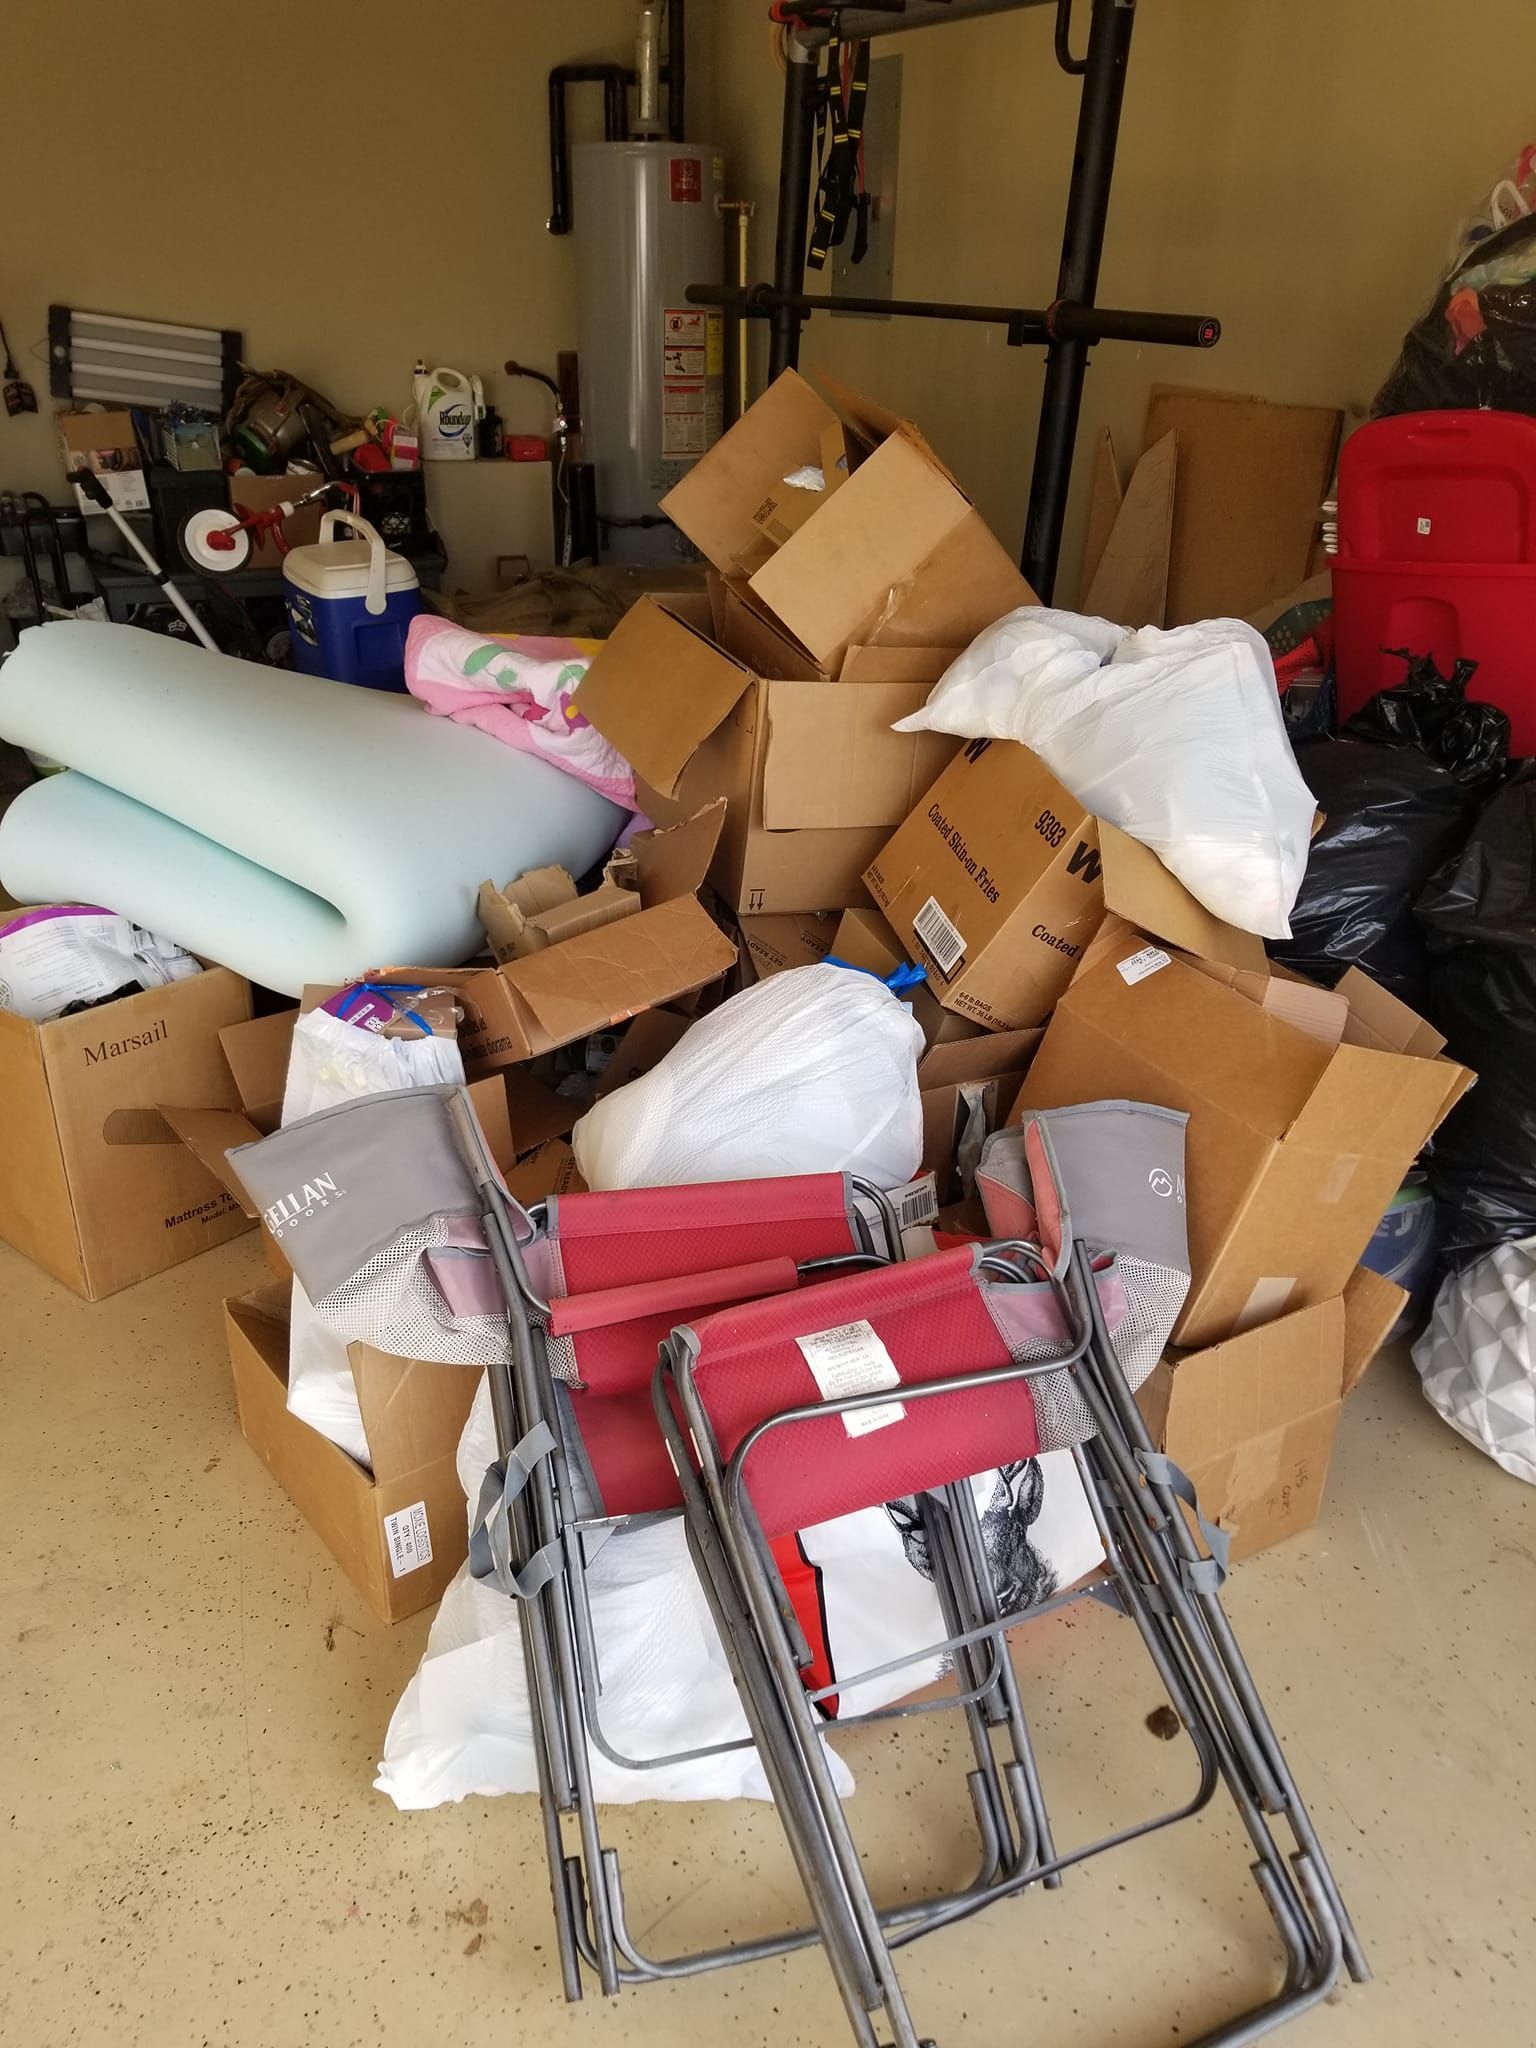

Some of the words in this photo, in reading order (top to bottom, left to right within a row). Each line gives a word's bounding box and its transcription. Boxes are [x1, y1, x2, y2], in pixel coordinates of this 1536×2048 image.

[1034, 810, 1067, 849] 9393
[928, 803, 955, 840] Coated
[948, 831, 978, 876] Skin-on
[974, 867, 1000, 904] Fries
[1065, 840, 1101, 884] W
[1031, 924, 1081, 958] Coated
[953, 998, 967, 1009] NET
[975, 1000, 993, 1011] BAGS
[83, 1019, 168, 1067] Marsail
[165, 1199, 218, 1229] Mattress
[391, 1517, 399, 1536] TWIN
